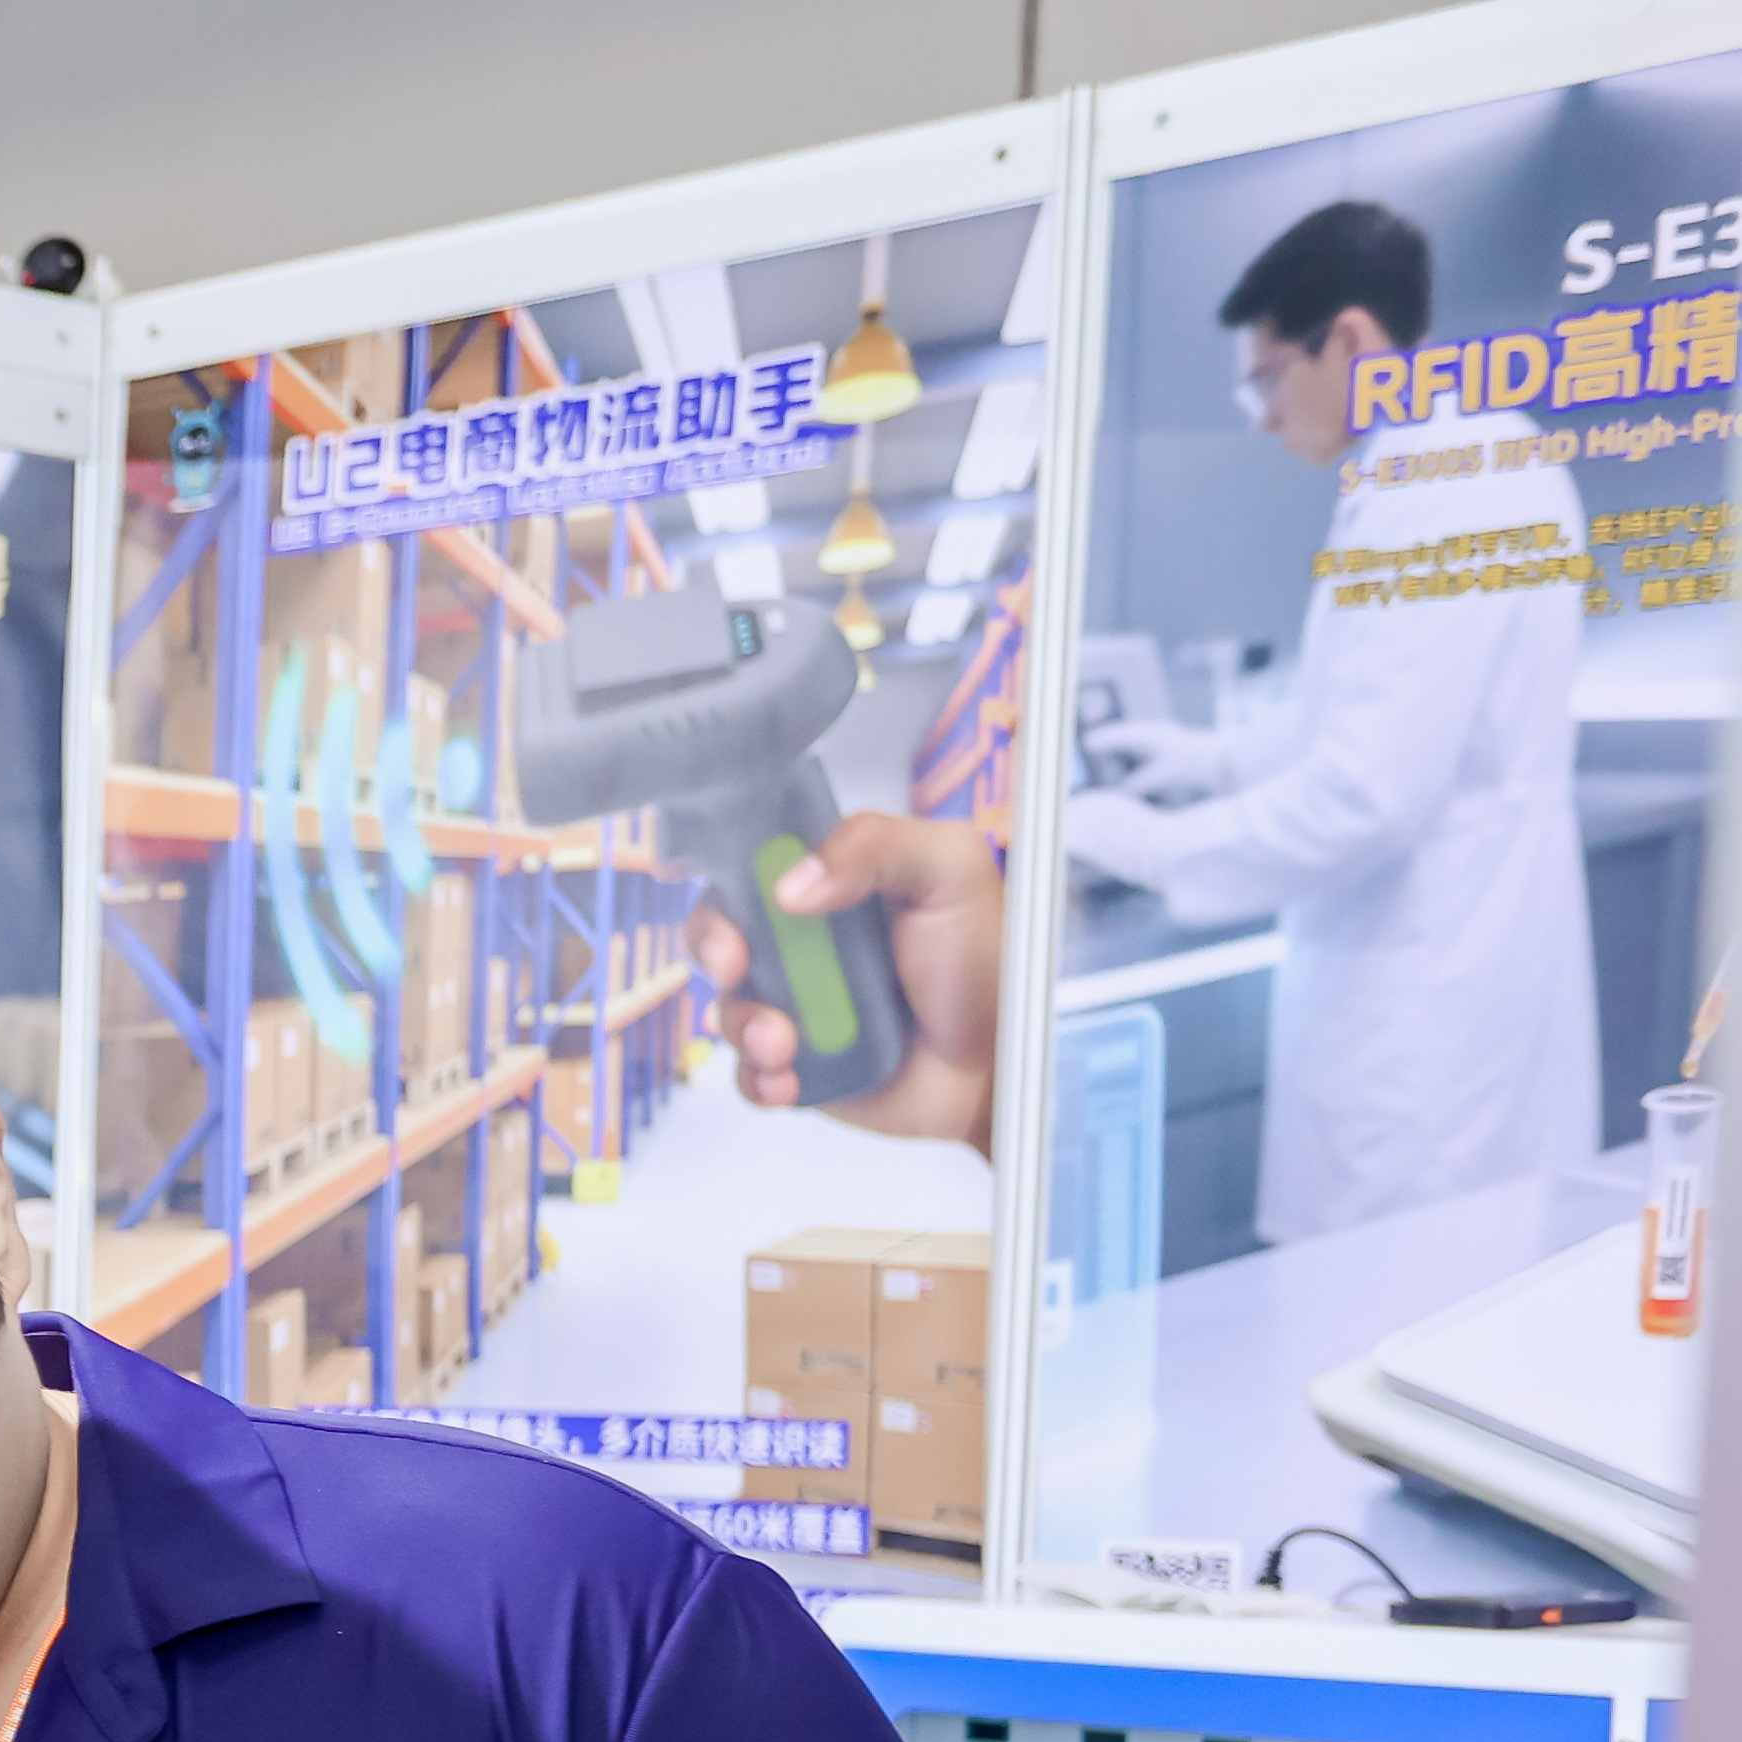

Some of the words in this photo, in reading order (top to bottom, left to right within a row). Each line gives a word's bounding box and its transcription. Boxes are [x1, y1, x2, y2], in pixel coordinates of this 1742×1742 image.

[287, 352, 822, 505] U2电商物流助手
